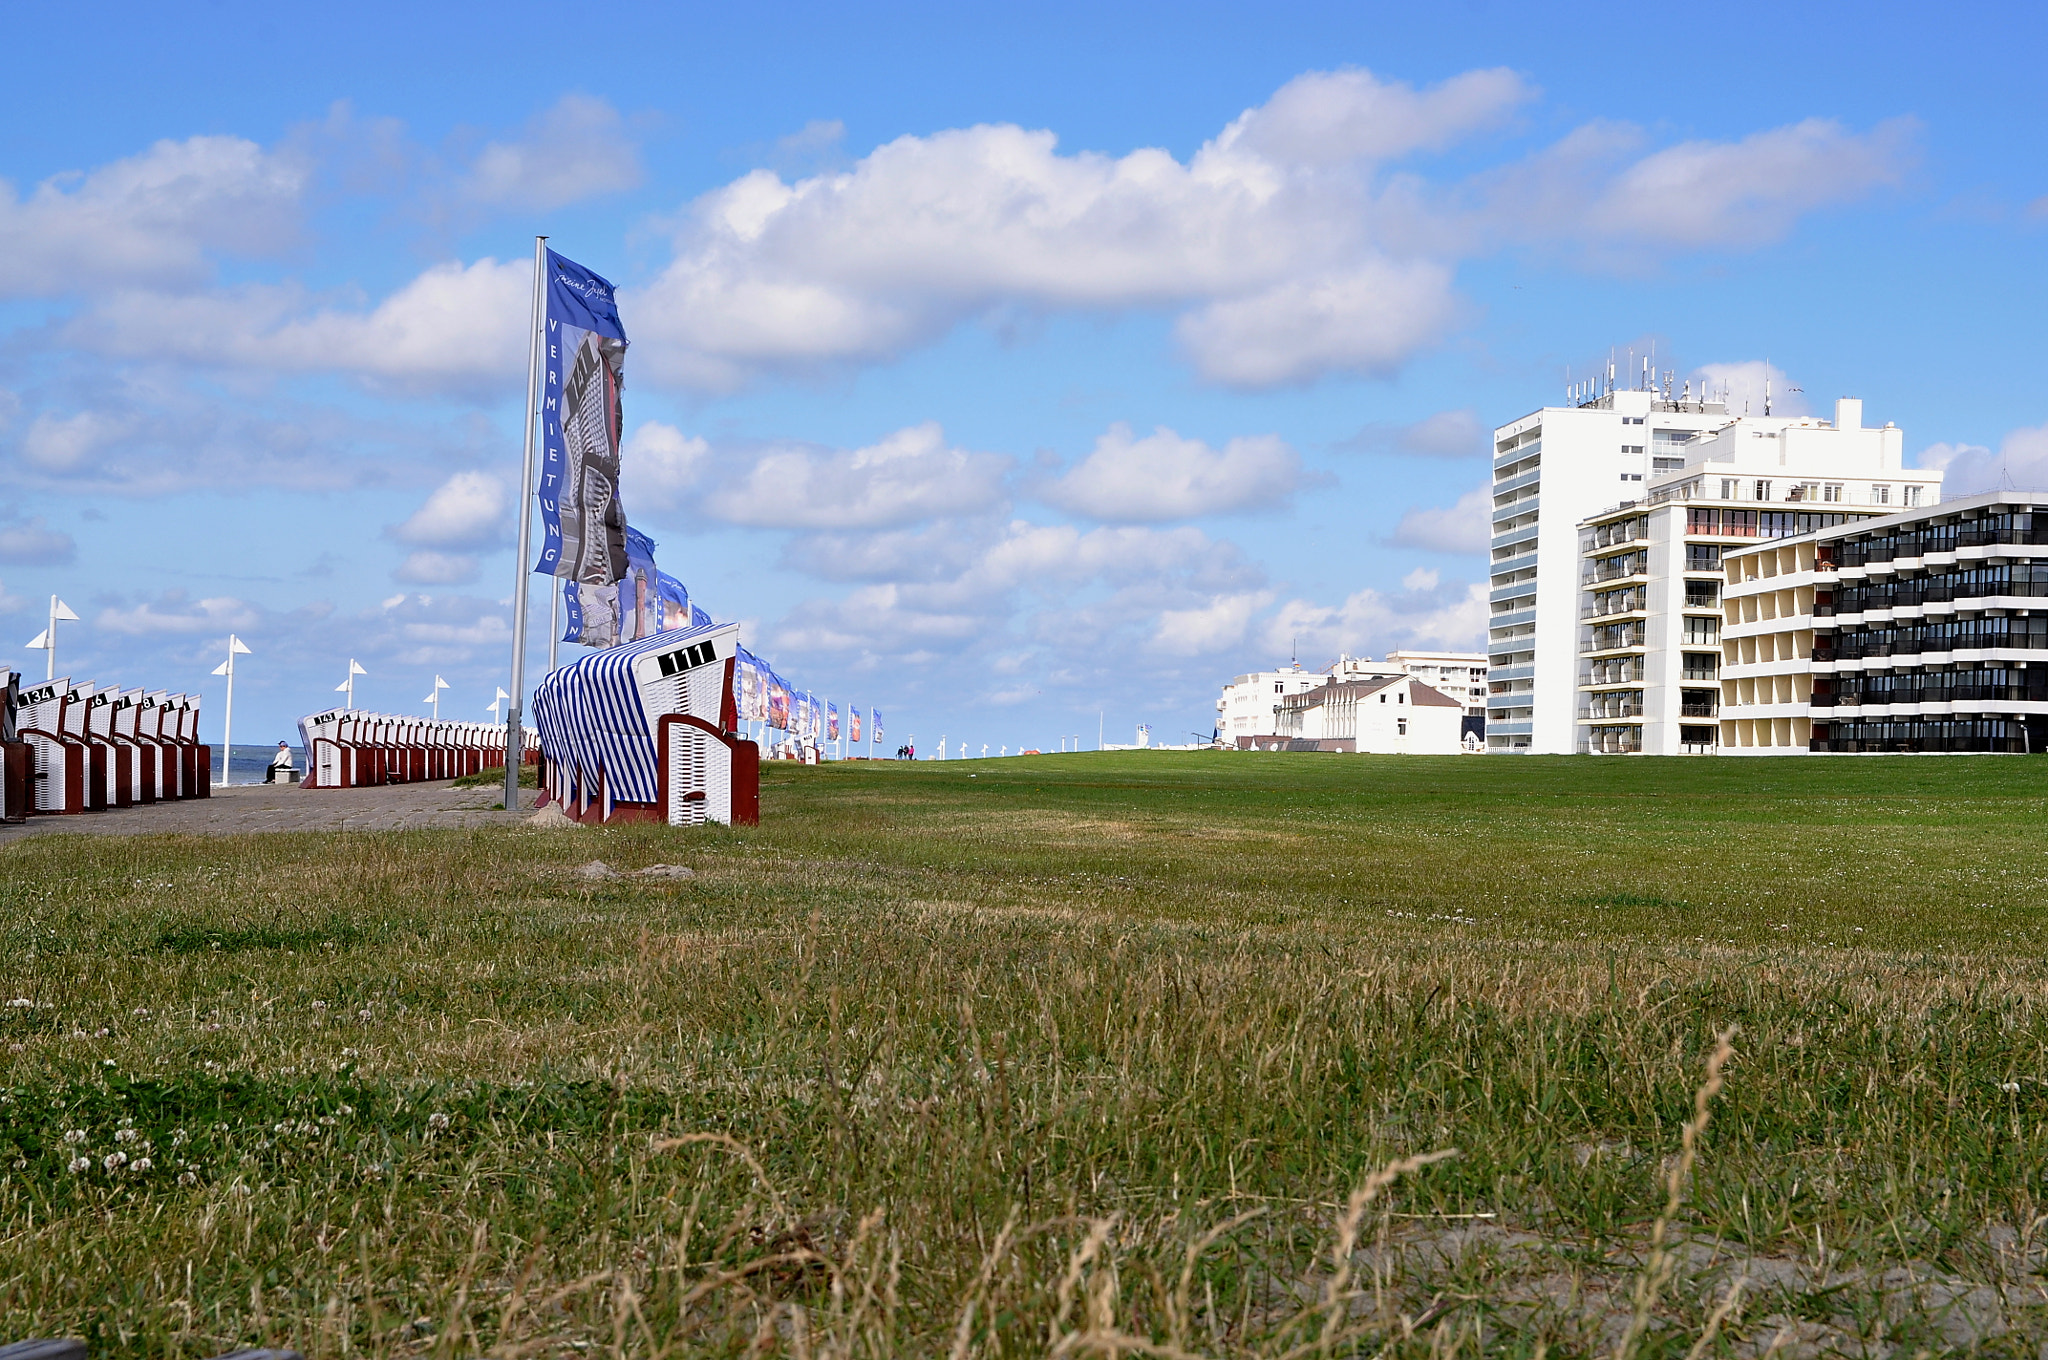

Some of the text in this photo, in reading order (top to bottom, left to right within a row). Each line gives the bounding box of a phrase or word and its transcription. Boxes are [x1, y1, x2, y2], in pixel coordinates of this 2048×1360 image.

[554, 274, 585, 291] meine
[544, 318, 559, 562] VERMIETUNG
[668, 644, 705, 673] 111
[24, 687, 51, 705] 134
[318, 713, 333, 724] 143
